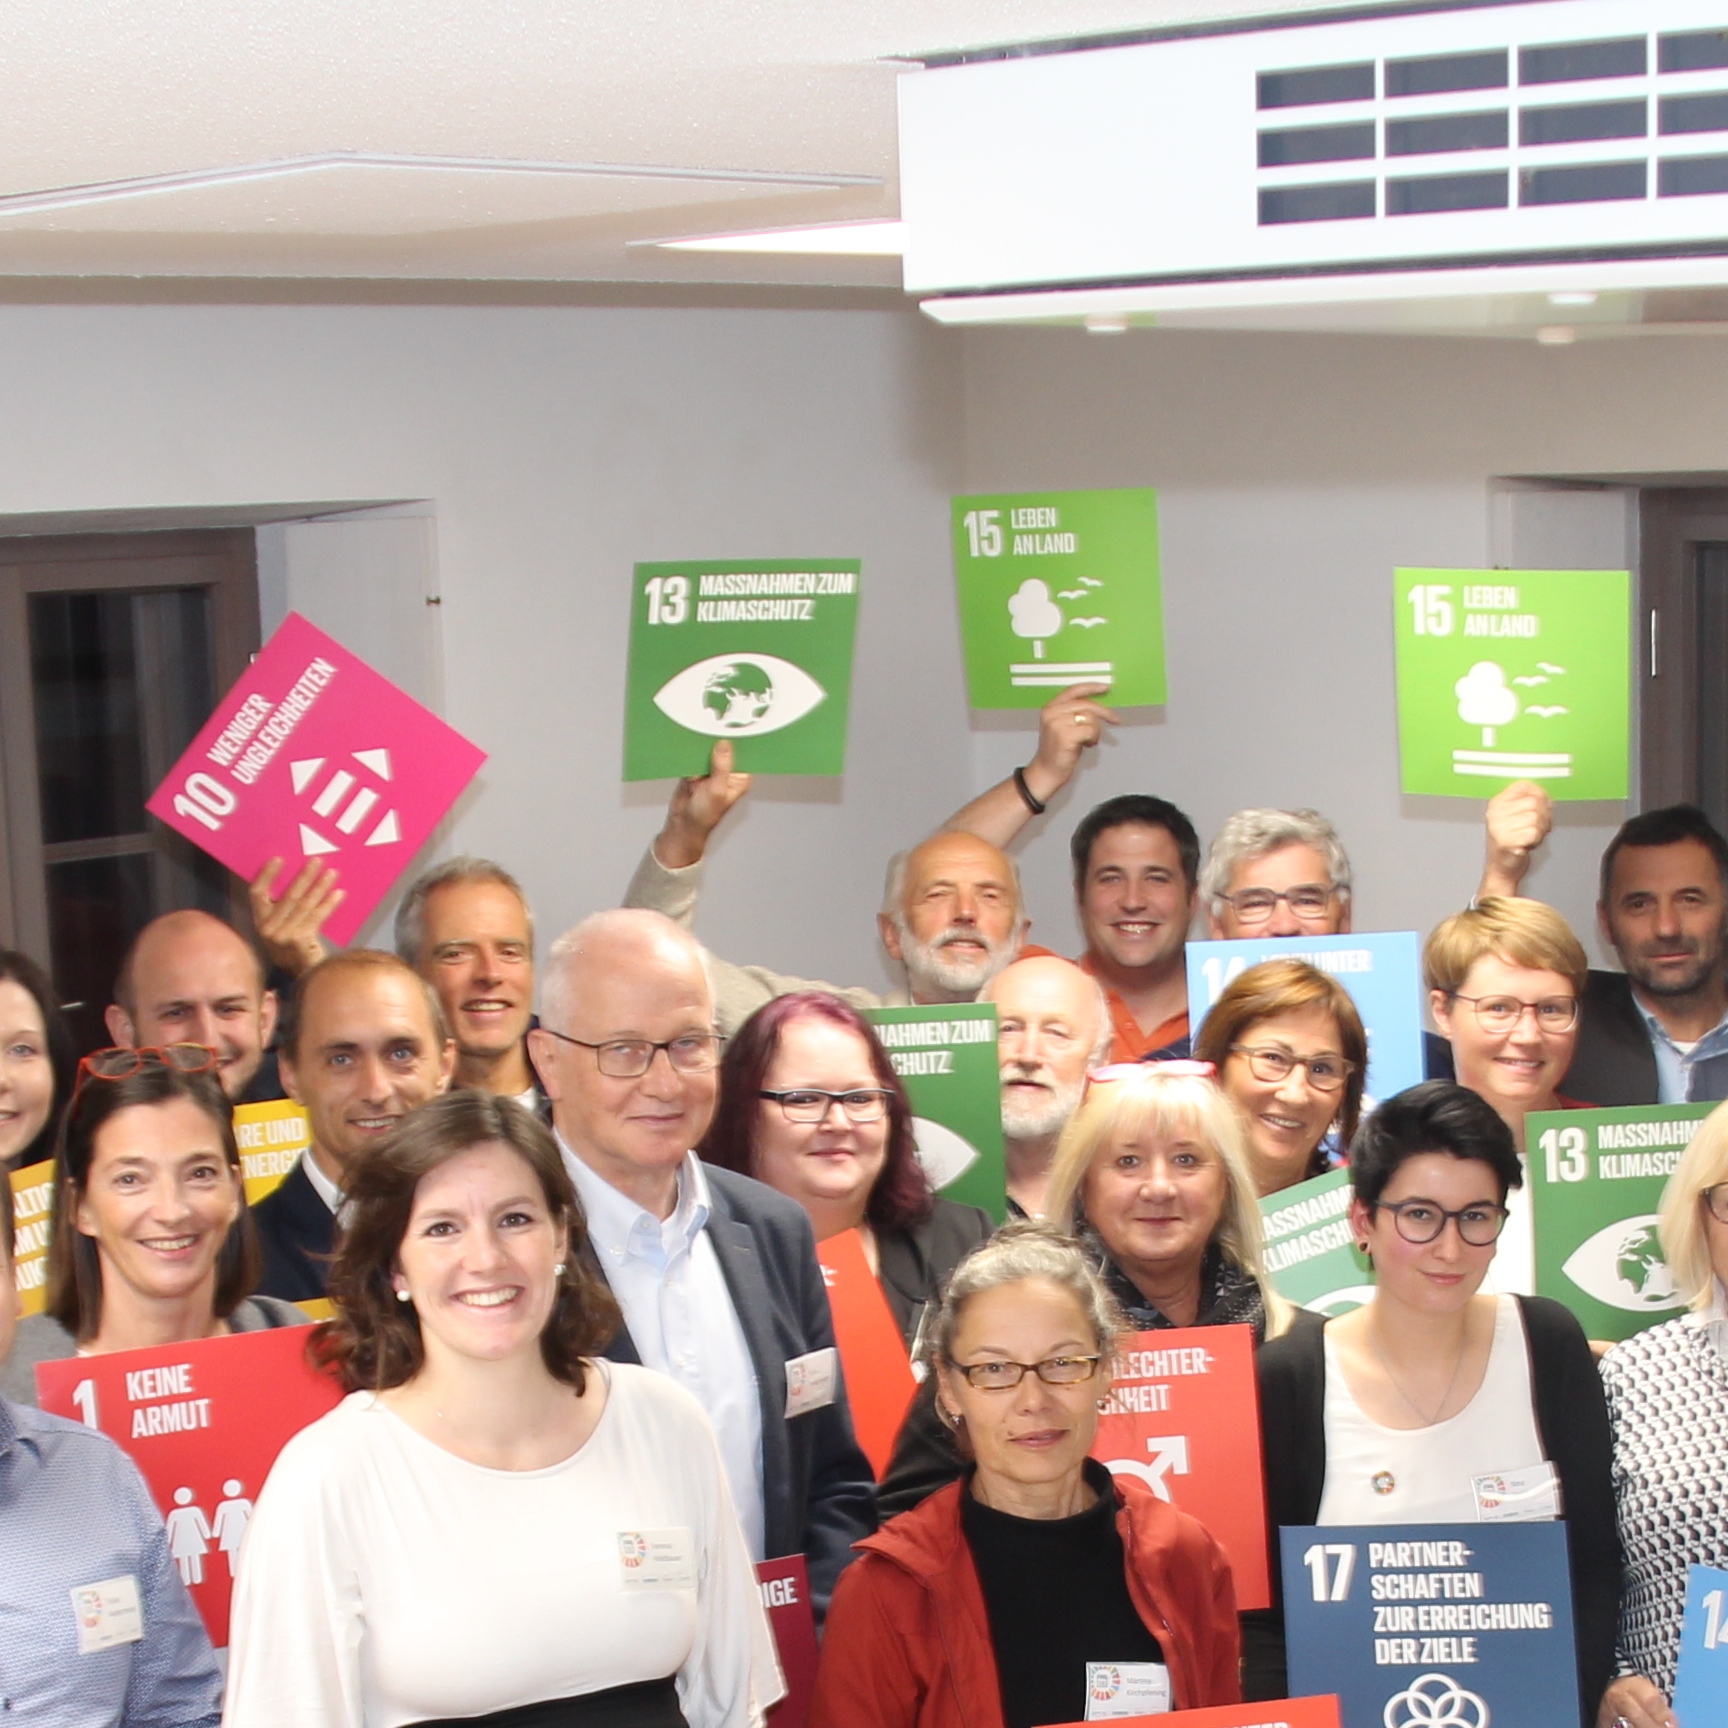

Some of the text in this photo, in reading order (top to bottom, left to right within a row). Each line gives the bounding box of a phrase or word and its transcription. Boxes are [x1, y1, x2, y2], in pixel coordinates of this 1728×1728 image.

[963, 509, 1002, 557] 15
[1011, 507, 1057, 529] LEBEN
[1013, 532, 1076, 556] AN LAND
[699, 573, 855, 596] MASSNAHMEN ZUM
[1463, 585, 1518, 609] LEBEN
[644, 575, 689, 625] 13
[697, 599, 815, 622] KLIMASCHUTZ
[1408, 584, 1453, 636] 15
[1464, 614, 1539, 637] AN LAND
[206, 694, 274, 766] WENIGER
[230, 657, 338, 784] UNGLEICHHEITEN
[173, 772, 236, 831] 10
[950, 1020, 992, 1043] ZUM
[233, 1117, 305, 1147] RE UND
[1598, 1119, 1705, 1149] MASSNAHM
[239, 1147, 307, 1178] NERG
[1539, 1127, 1587, 1183] 13
[1599, 1152, 1679, 1179] KLIMASC
[1262, 1184, 1355, 1242] ASSNAHM
[126, 1363, 194, 1401] KEINE
[73, 1379, 97, 1430] 1
[132, 1399, 210, 1438] ARMUT
[1368, 1541, 1473, 1568] PARTNER-
[1304, 1544, 1356, 1602] 17
[1371, 1573, 1484, 1600] SCHAFTEN
[1373, 1603, 1552, 1632] ZUR ERREICHUNG
[1374, 1637, 1478, 1664] DER ZIELE
